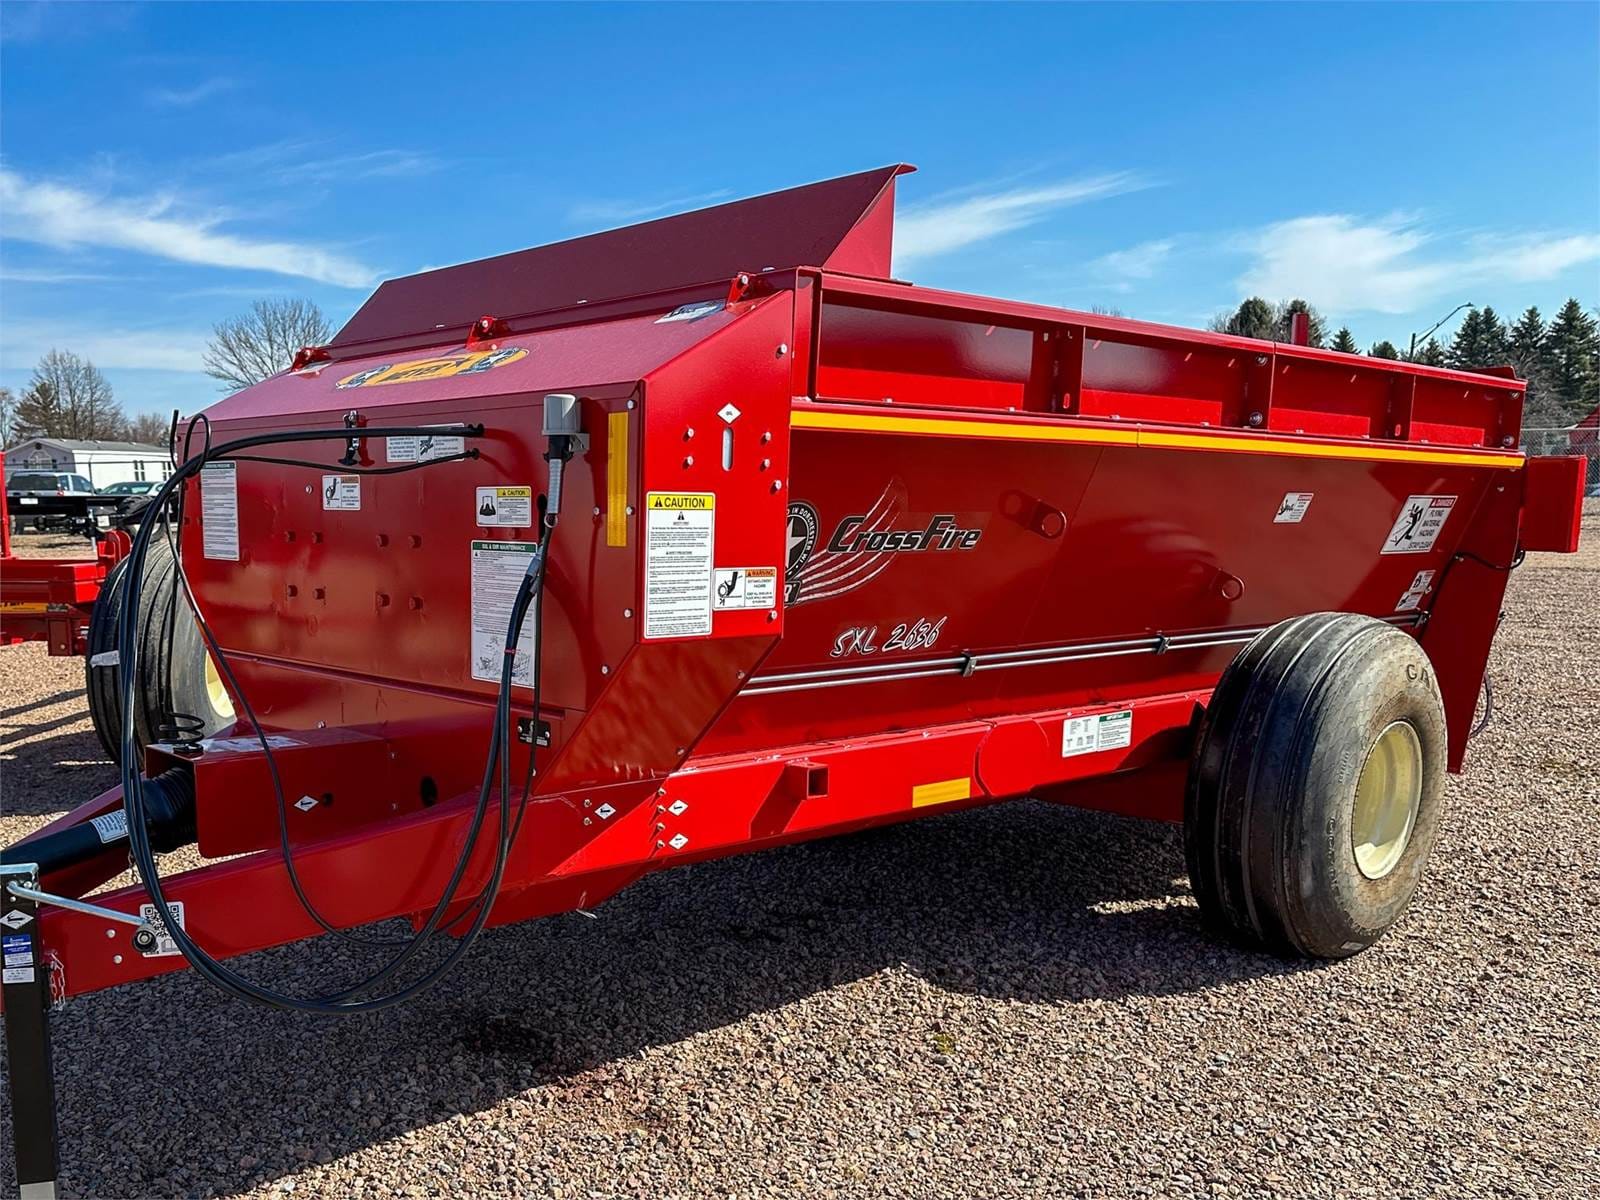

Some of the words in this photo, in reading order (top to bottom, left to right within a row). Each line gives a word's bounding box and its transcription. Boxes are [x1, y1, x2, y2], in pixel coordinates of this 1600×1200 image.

[664, 497, 705, 508] CAUTION
[799, 508, 816, 551] DORCHESTER
[828, 514, 982, 554] CrossFire
[830, 626, 878, 658] SXL
[882, 615, 947, 653] 2636
